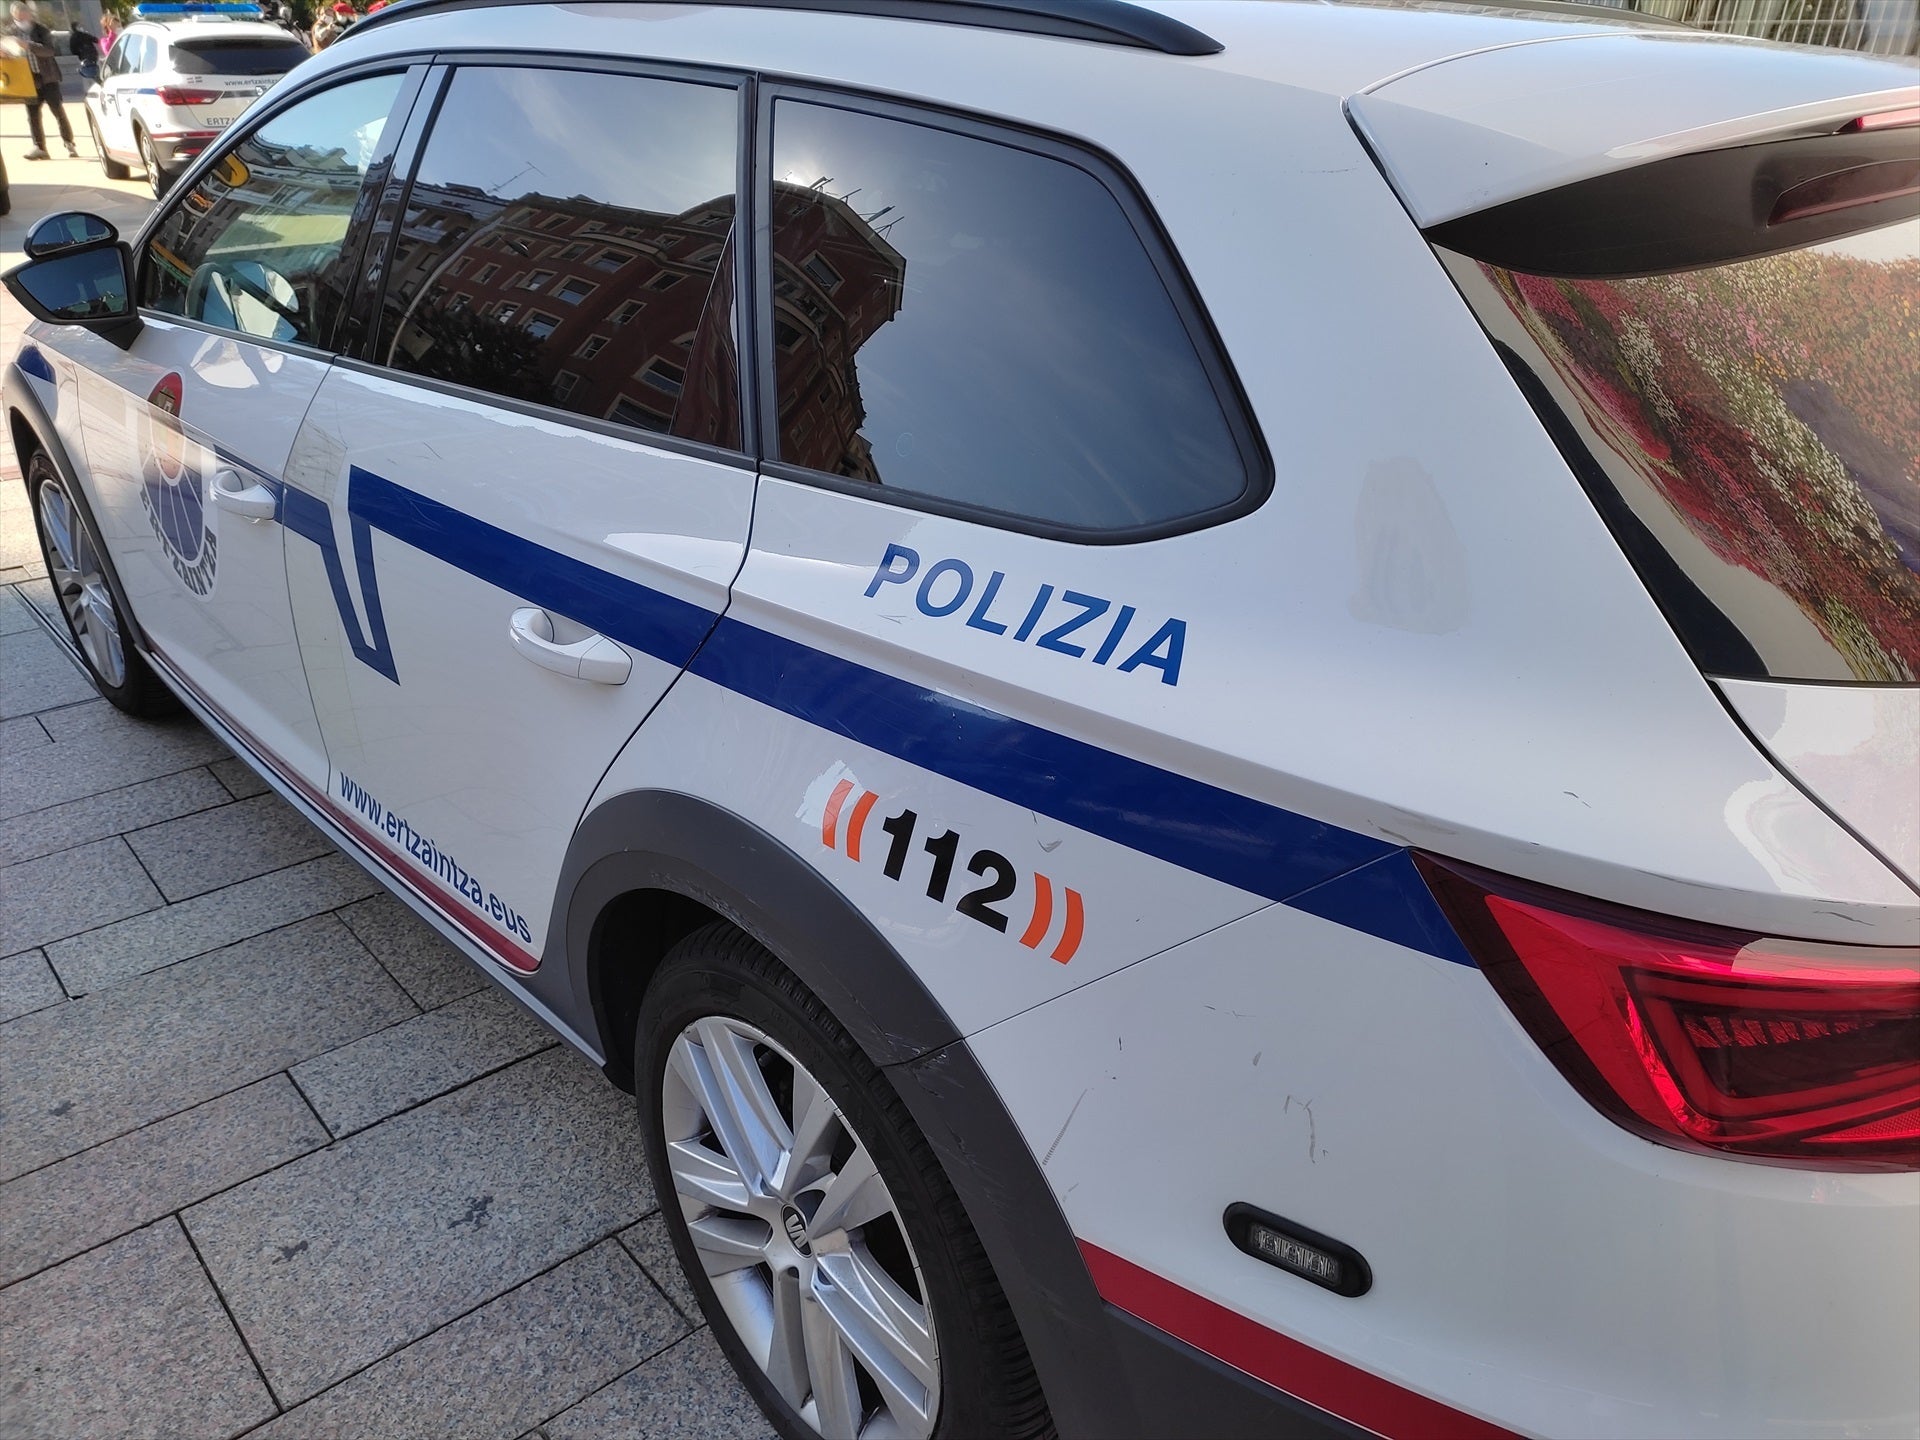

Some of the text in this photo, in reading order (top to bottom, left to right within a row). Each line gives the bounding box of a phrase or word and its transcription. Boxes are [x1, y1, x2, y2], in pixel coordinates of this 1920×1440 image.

[140, 485, 217, 596] ERTZAINTZA
[864, 543, 1188, 687] POLIZIA
[340, 771, 532, 943] www.ertzaintza.eus
[882, 808, 1017, 934] 112
